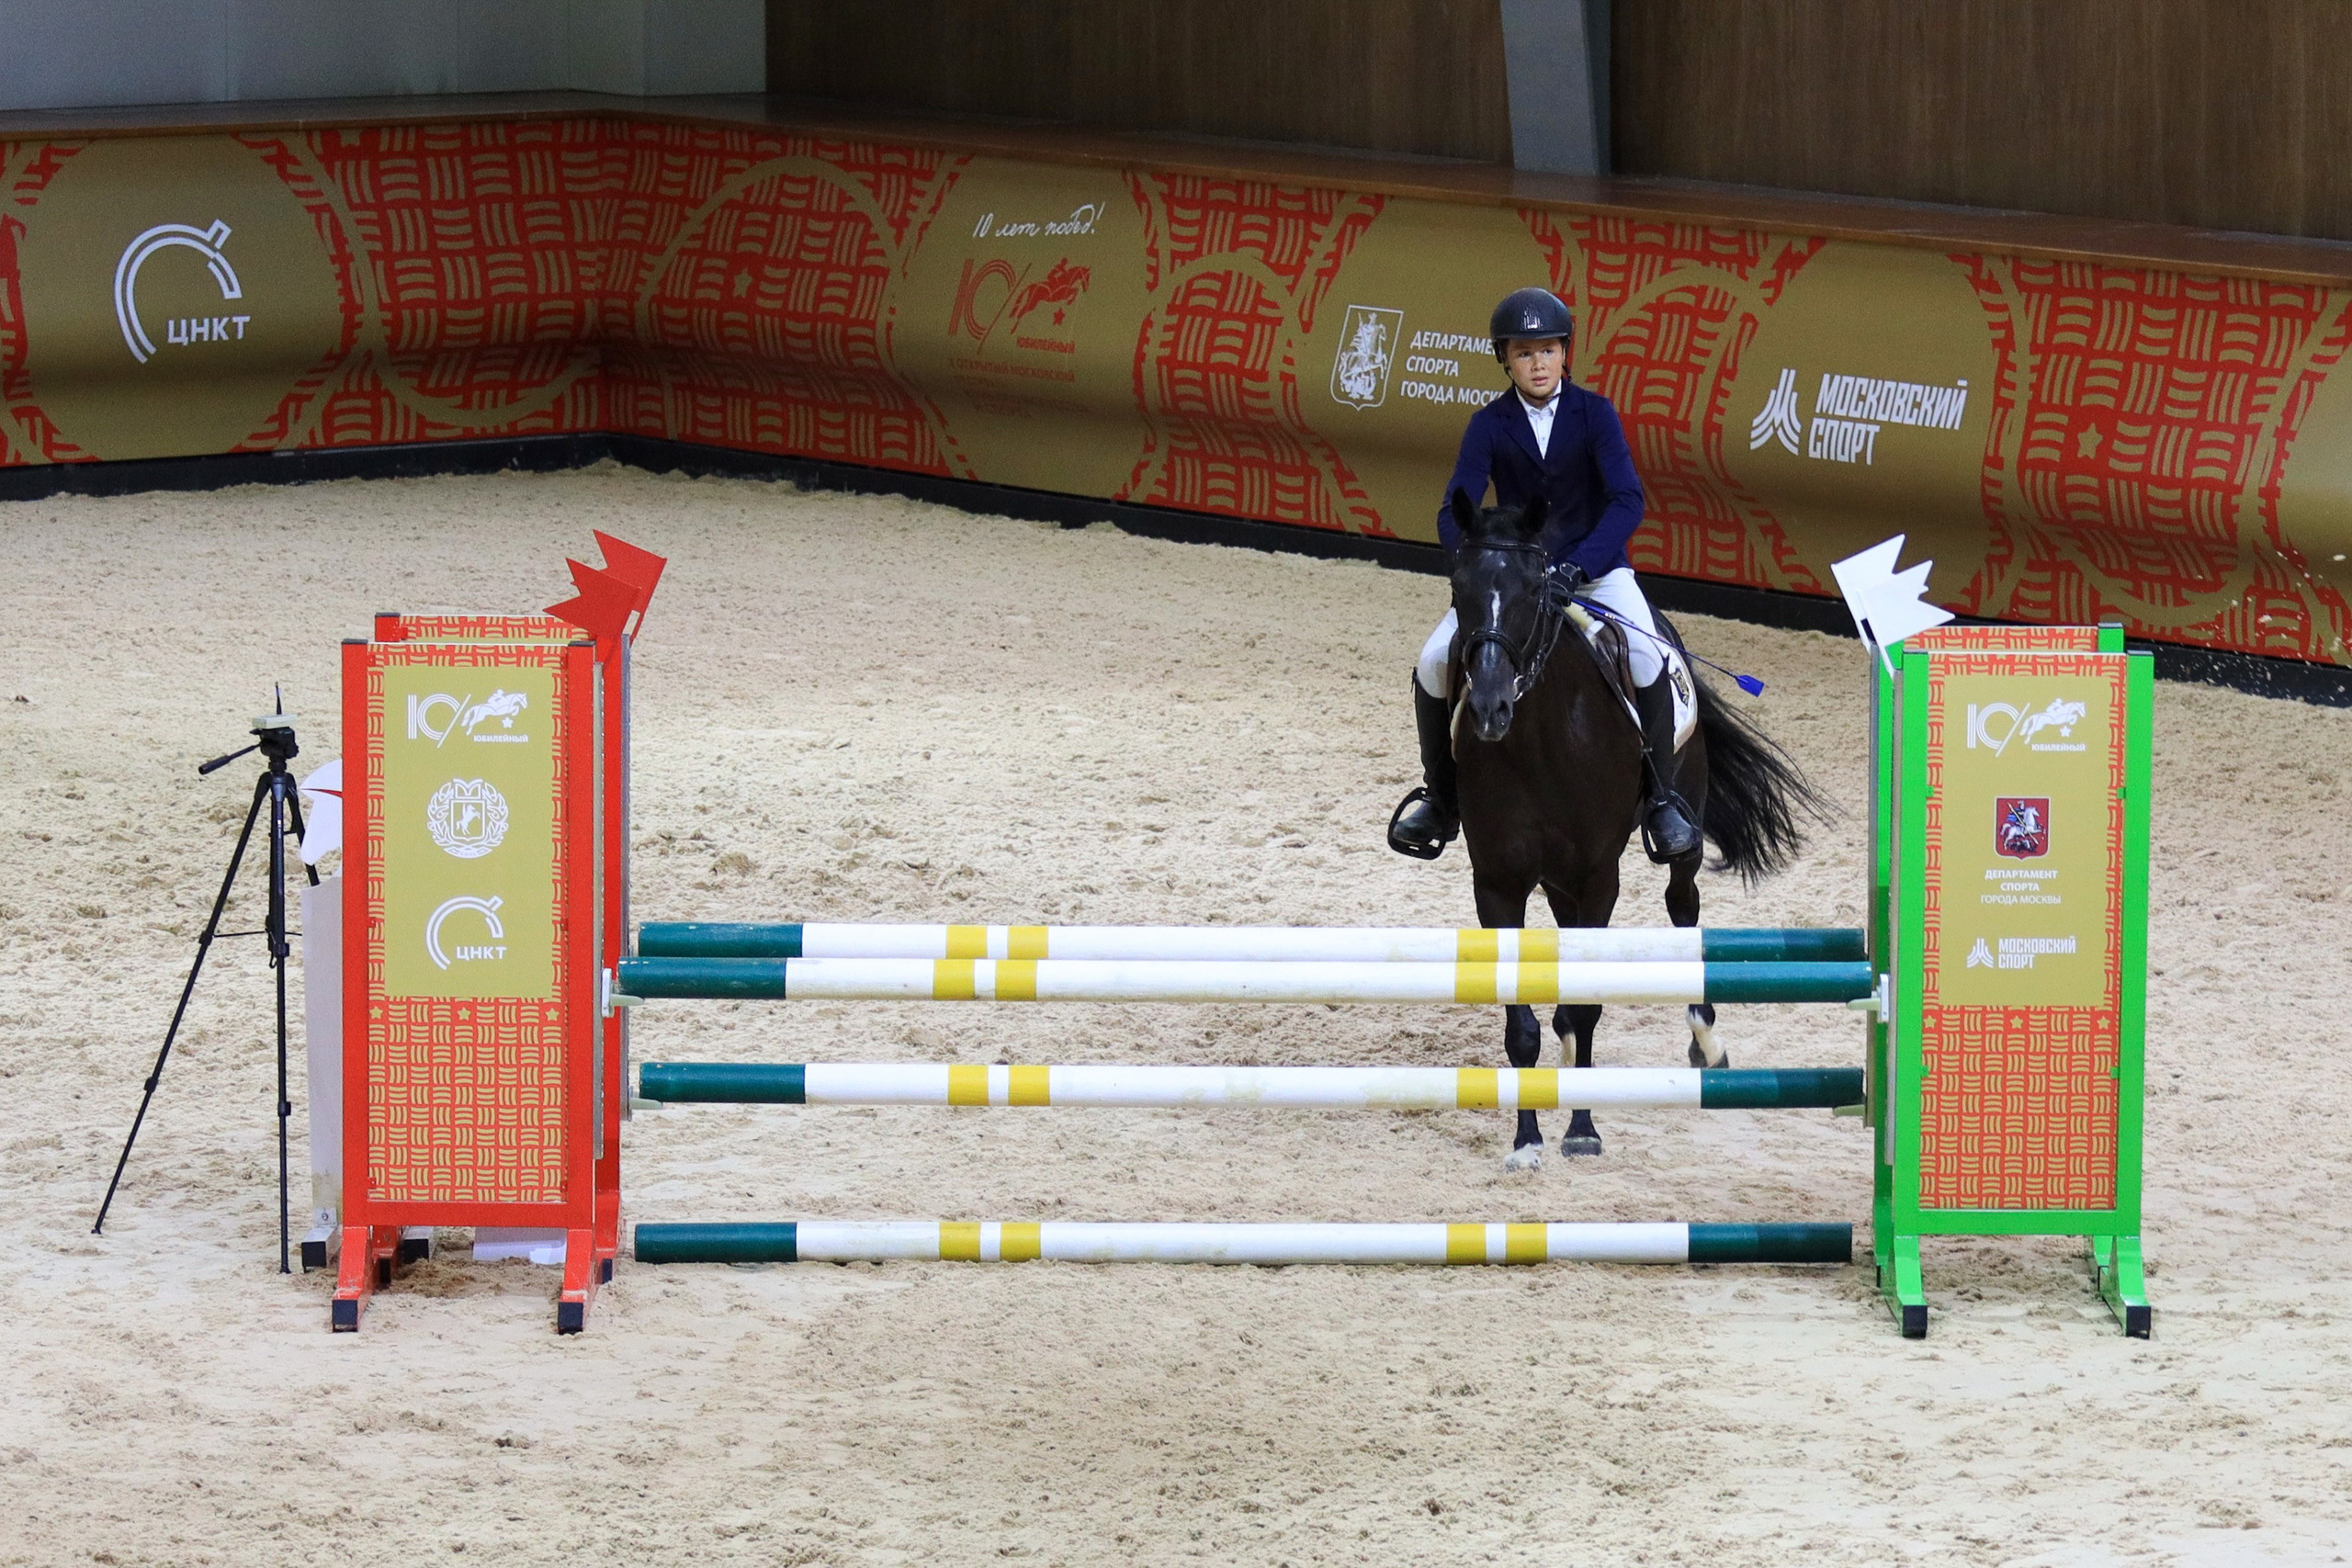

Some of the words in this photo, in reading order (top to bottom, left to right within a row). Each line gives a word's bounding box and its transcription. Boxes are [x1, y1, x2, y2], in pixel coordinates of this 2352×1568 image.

[996, 222, 1041, 237] лет
[167, 315, 251, 345] ЦНКТ
[1409, 331, 1495, 355] ДЕПАРТАМЕ
[1406, 355, 1459, 378] СПОРТА
[1401, 378, 1454, 405] ГОРОДА
[1457, 387, 1505, 407] МОСК
[1814, 373, 1968, 430] МОСКОВСКИЙ
[1808, 417, 1881, 466] СПОРТ
[473, 734, 529, 743] ЮБИЛЕЙНЫЙ
[2030, 742, 2086, 752] ЮБИЛЕЙНЫЙ
[1984, 869, 2058, 882] ДЕПАРТАМЕНТ
[1999, 882, 2040, 893] СПОРТА
[1980, 894, 2018, 906] ГОРОДА
[2019, 894, 2062, 905] МОСКВЫ
[1997, 935, 2076, 954] МОСКОВСКИЙ
[456, 945, 507, 962] ЦНКТ
[1997, 953, 2035, 969] СПОРТ
